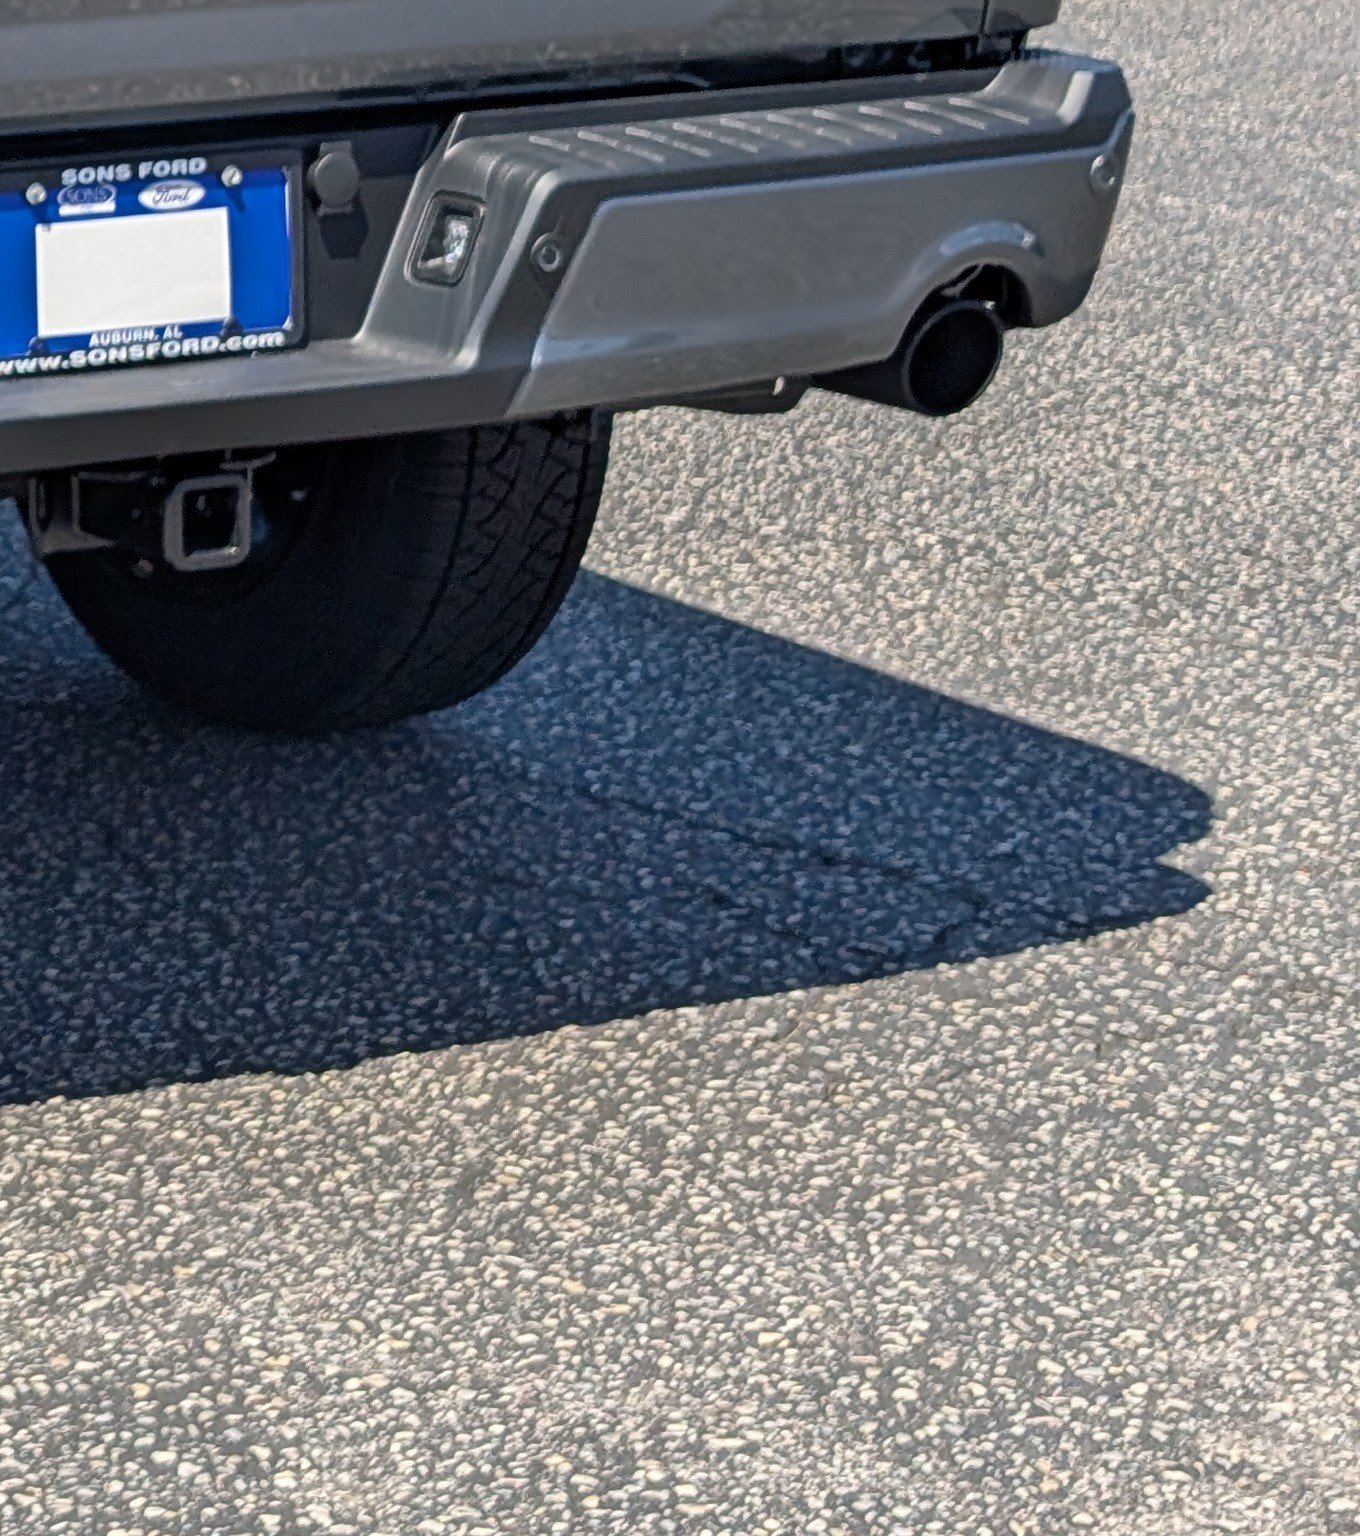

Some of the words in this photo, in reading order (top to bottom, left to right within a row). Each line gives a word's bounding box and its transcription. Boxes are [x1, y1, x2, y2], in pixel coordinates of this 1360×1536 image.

[61, 163, 133, 186] SONS
[138, 157, 207, 179] FORD
[163, 324, 183, 339] AL
